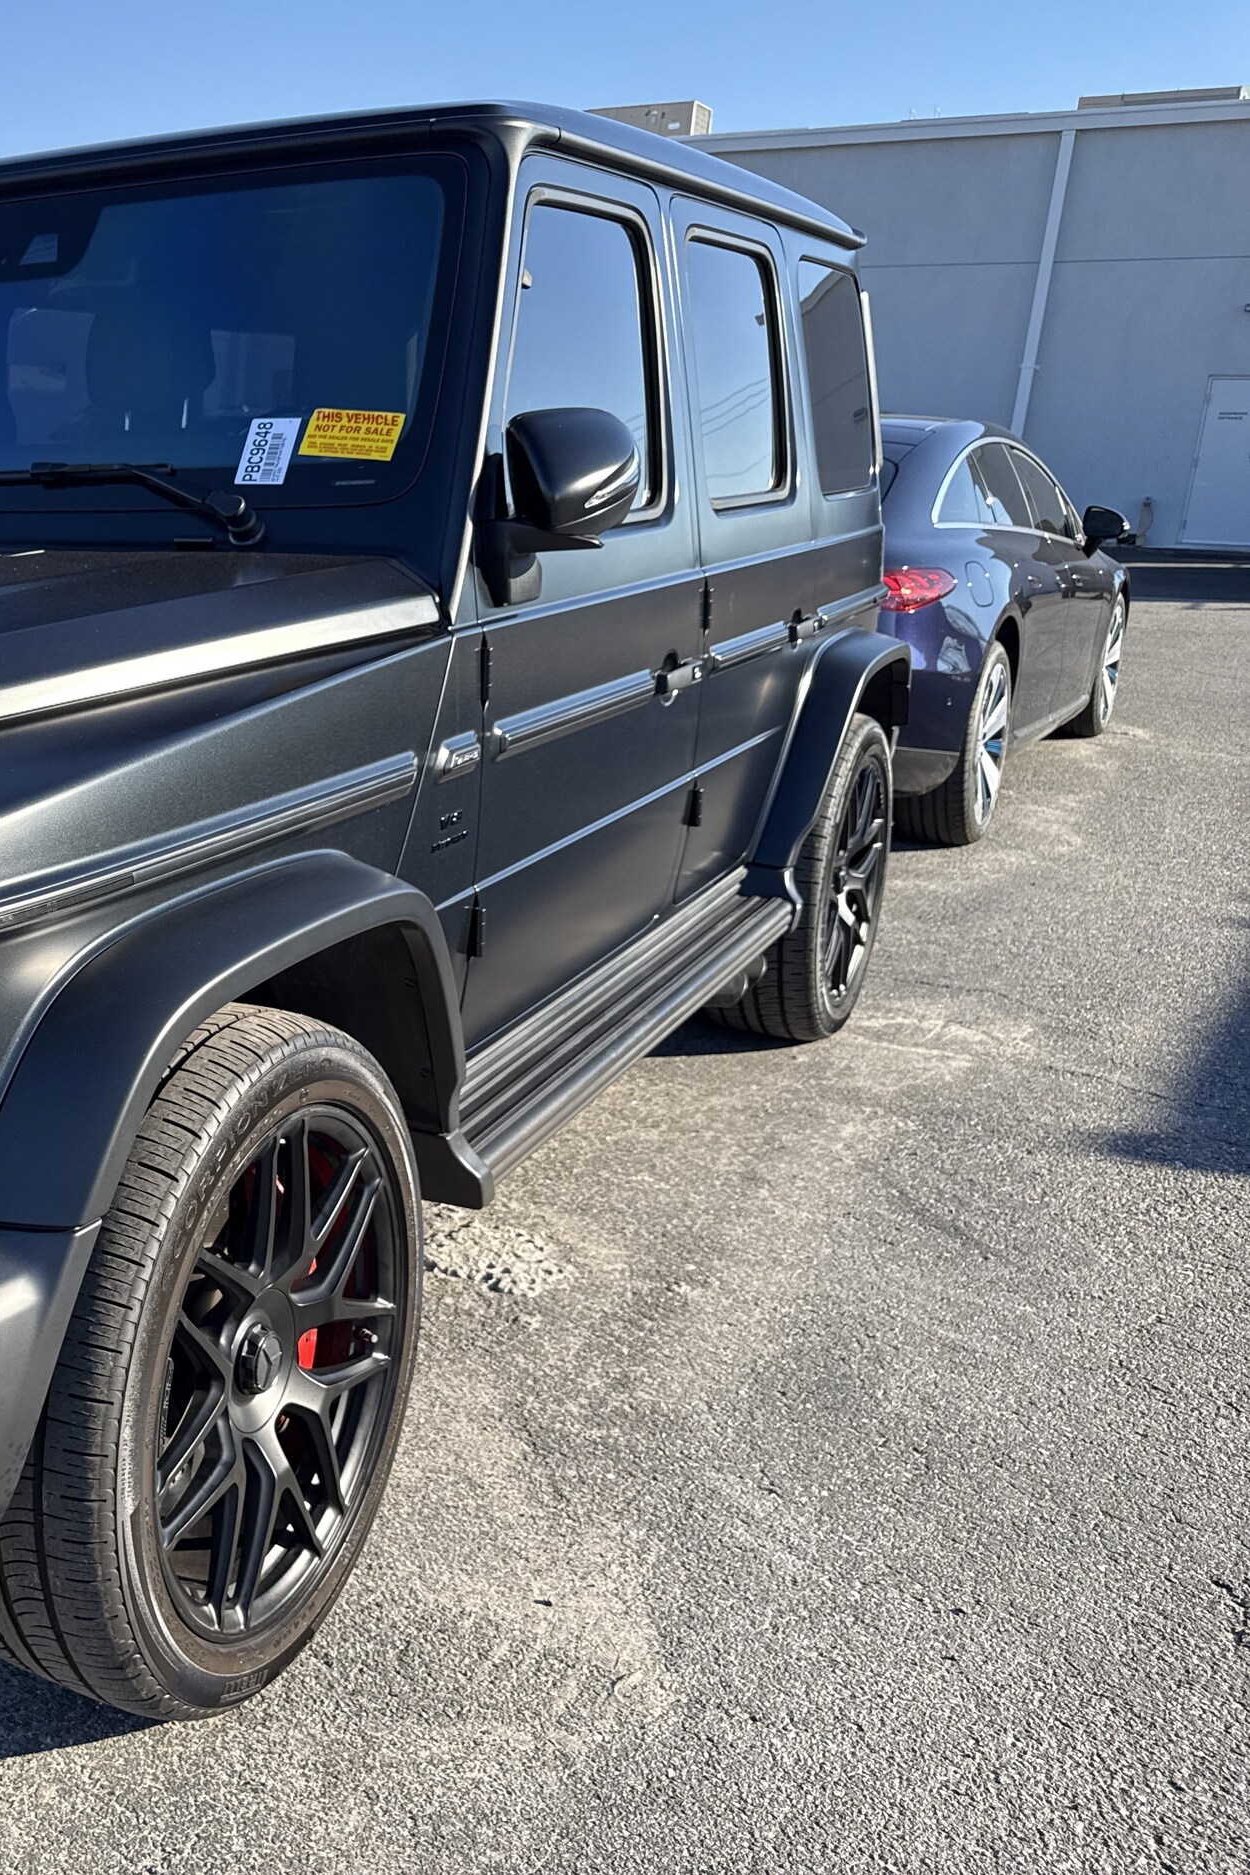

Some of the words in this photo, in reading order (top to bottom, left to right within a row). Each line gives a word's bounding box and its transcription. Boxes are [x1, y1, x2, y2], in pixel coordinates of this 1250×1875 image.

[316, 411, 342, 423] THIS
[346, 413, 400, 426] VEHICLE
[314, 423, 337, 433] NOT
[338, 425, 361, 435] FOR
[364, 427, 395, 437] SALE
[241, 421, 274, 482] PBC9648
